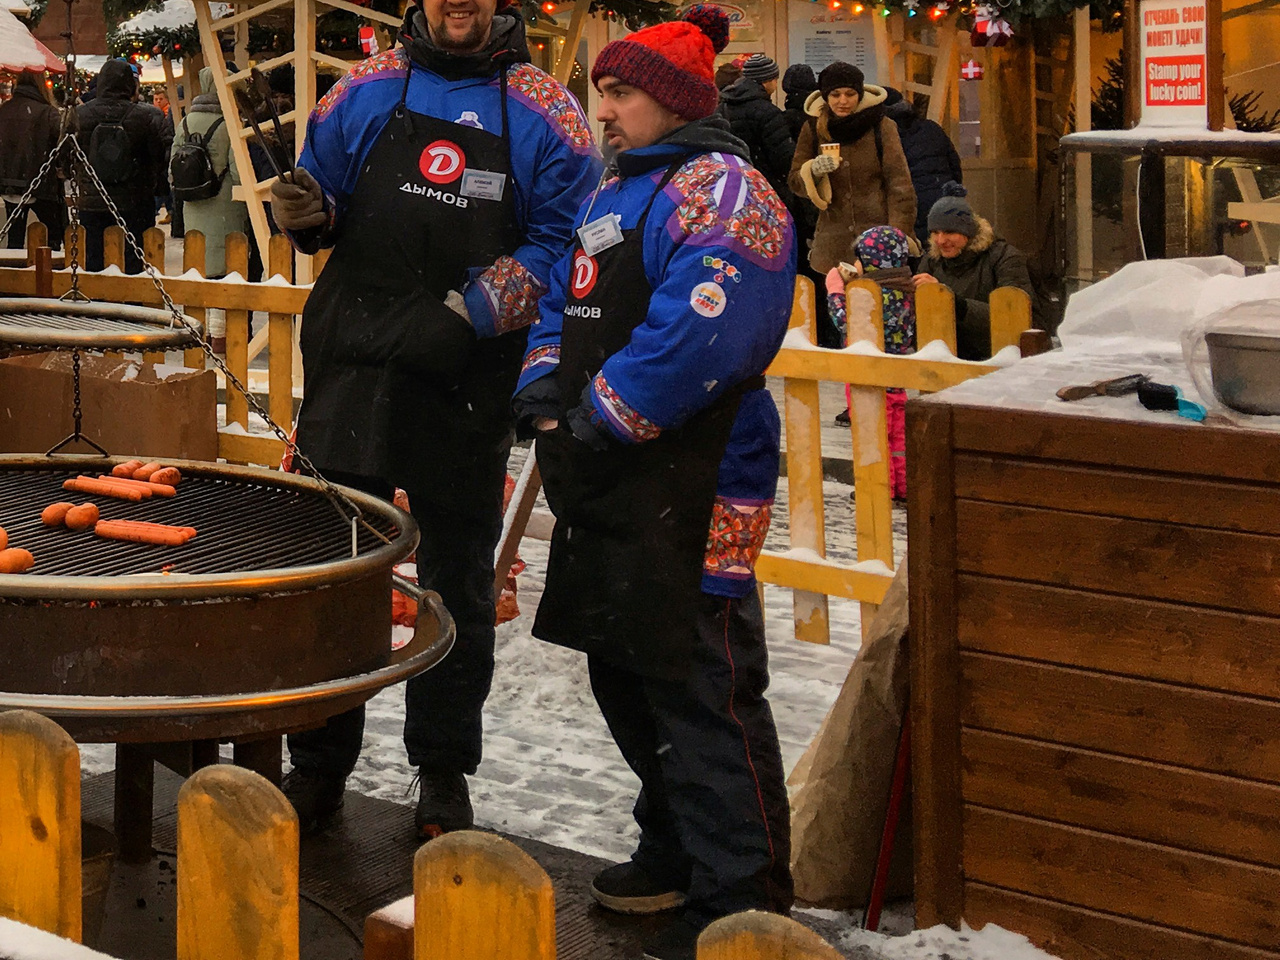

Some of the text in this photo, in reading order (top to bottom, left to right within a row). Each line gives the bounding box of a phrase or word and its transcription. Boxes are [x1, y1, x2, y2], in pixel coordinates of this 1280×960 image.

[1182, 5, 1205, 23] СВОЮ
[1146, 28, 1203, 47] МОНЕТУ УДАЧИ!
[1148, 62, 1201, 81] Stamp your
[1150, 82, 1201, 102] lucky coin!
[399, 182, 469, 209] ДЫМОВ
